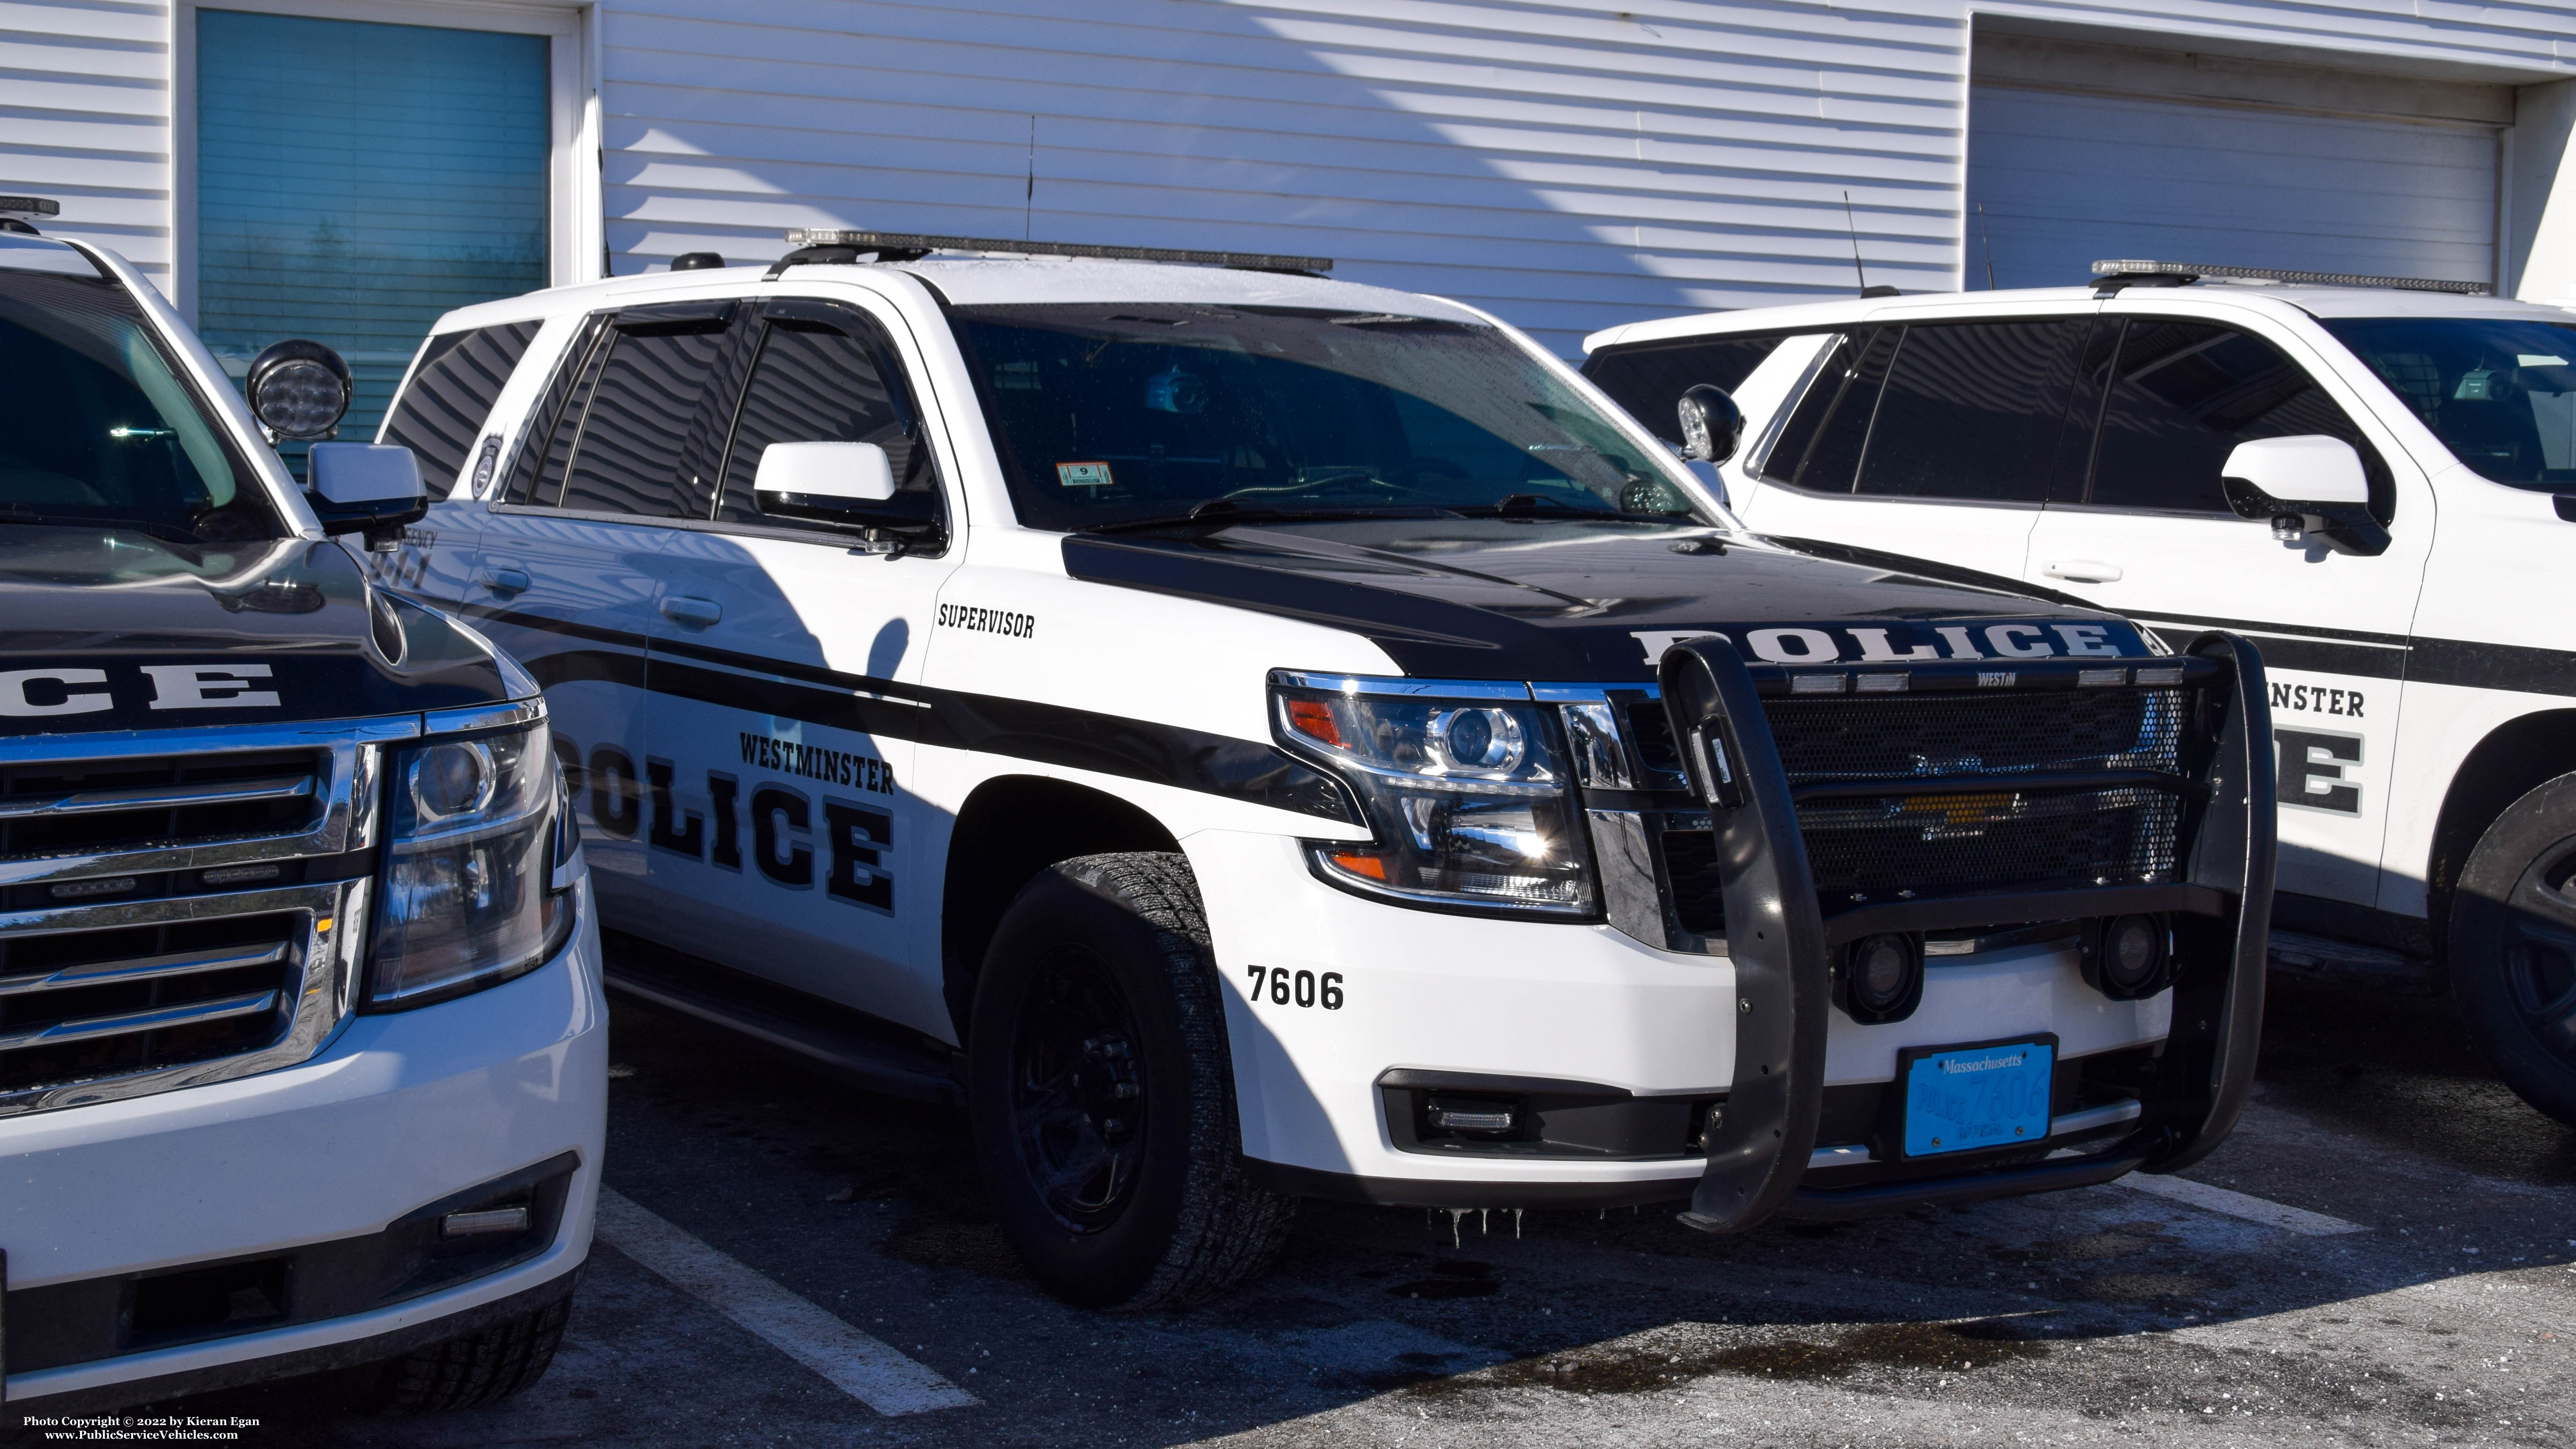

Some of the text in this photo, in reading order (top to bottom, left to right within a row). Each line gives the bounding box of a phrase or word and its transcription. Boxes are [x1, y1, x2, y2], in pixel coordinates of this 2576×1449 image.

[400, 527, 438, 550] GENCY
[938, 603, 1034, 639] SUPERVISOR
[2266, 682, 2364, 717] NSTER
[739, 732, 894, 795] WESTMINSTER
[1248, 965, 1343, 1010] 7606
[1944, 1055, 2022, 1075] Massachusetts
[1969, 1068, 2046, 1125] 7606
